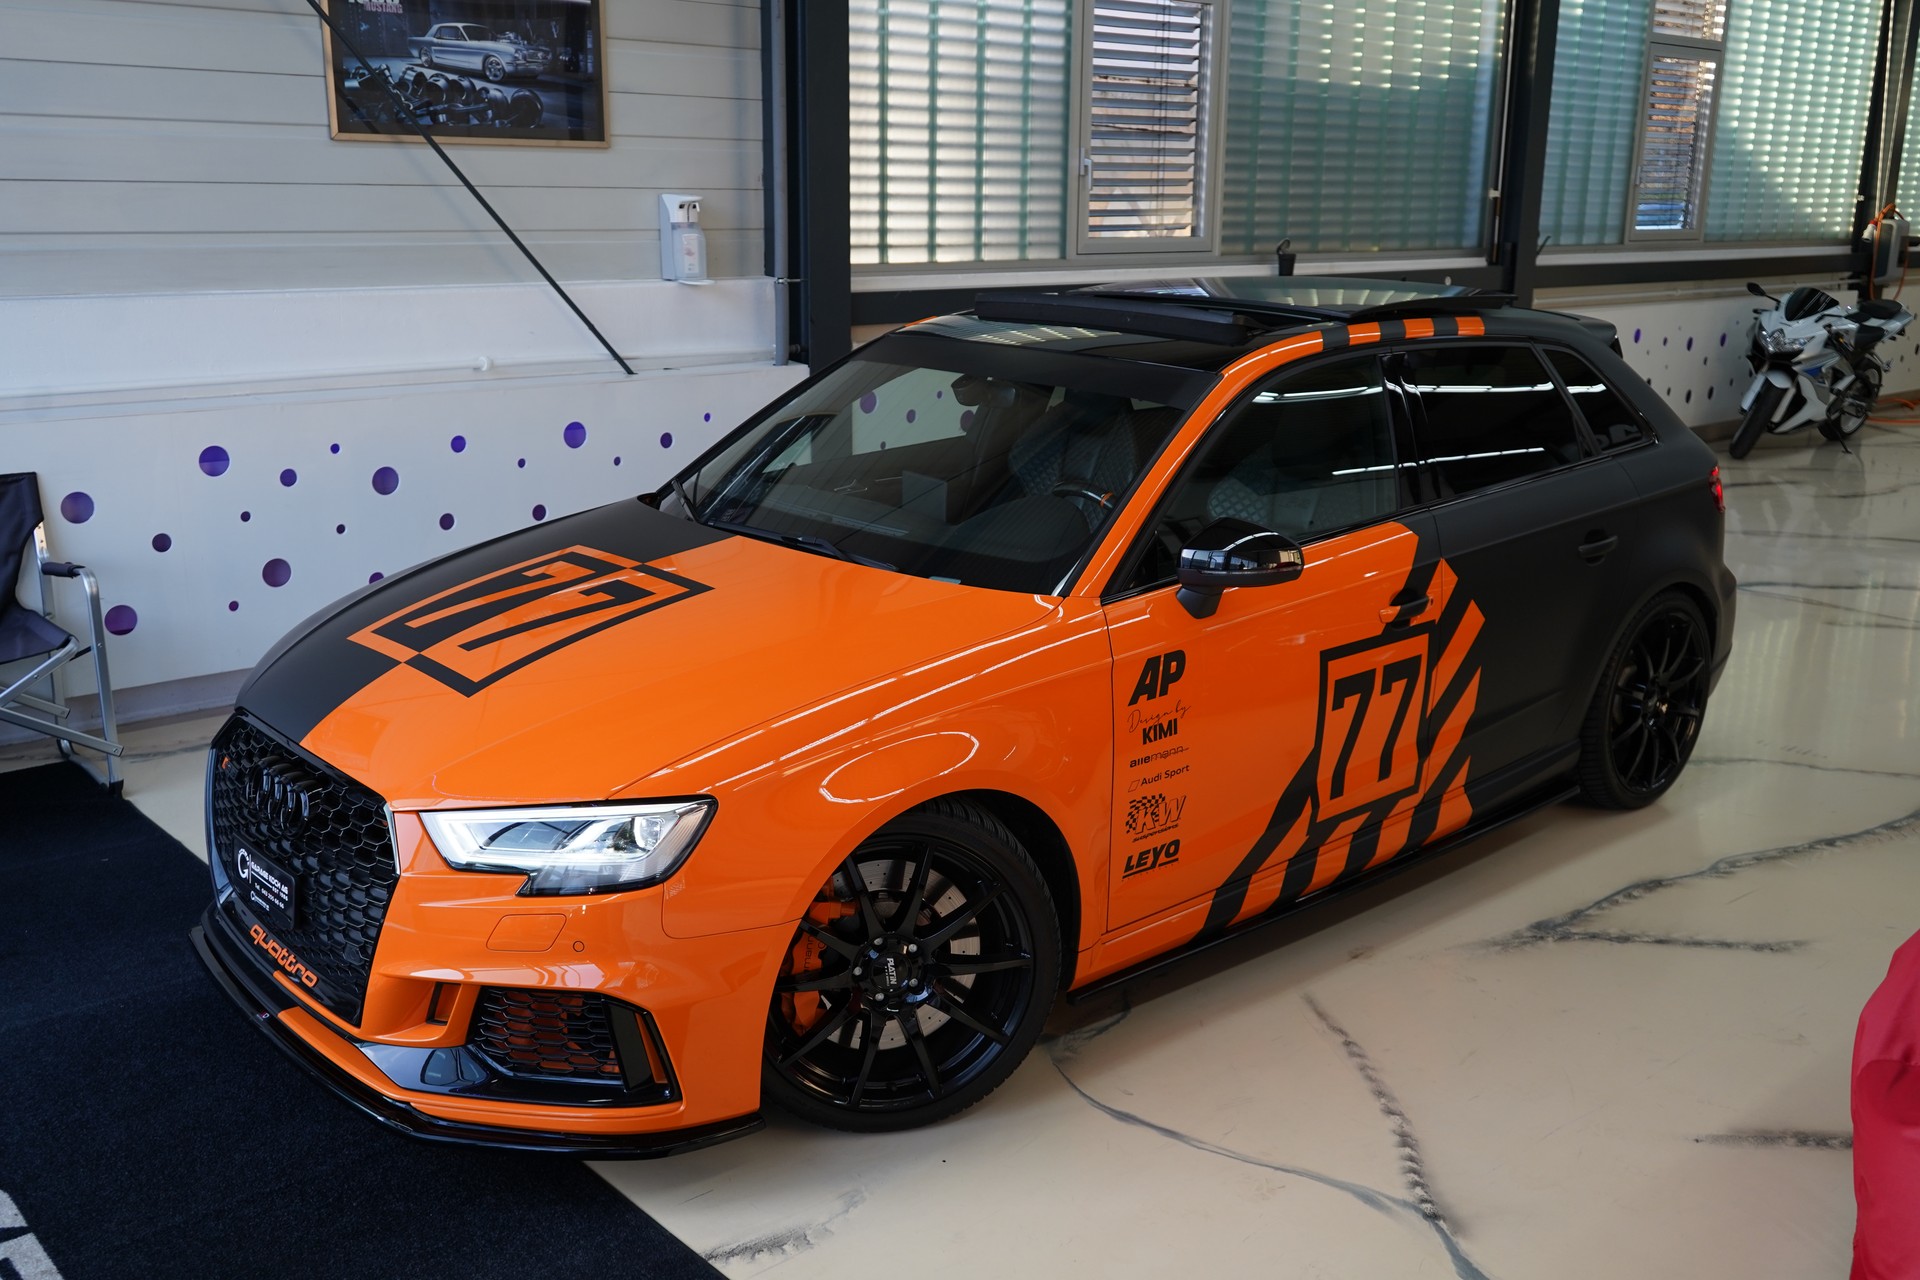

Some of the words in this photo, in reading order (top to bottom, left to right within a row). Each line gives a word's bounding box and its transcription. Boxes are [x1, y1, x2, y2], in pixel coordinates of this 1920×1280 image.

[364, 2, 403, 14] MUSTANG
[1127, 649, 1187, 707] AP
[1142, 717, 1178, 746] KIMI
[1329, 653, 1423, 801] 77
[1141, 772, 1162, 787] Audi
[1164, 764, 1190, 779] Sport
[1123, 838, 1181, 874] LEYO
[251, 861, 269, 880] GARAGE
[268, 874, 281, 889] KOCH
[281, 884, 289, 895] AG
[250, 924, 318, 988] quattro
